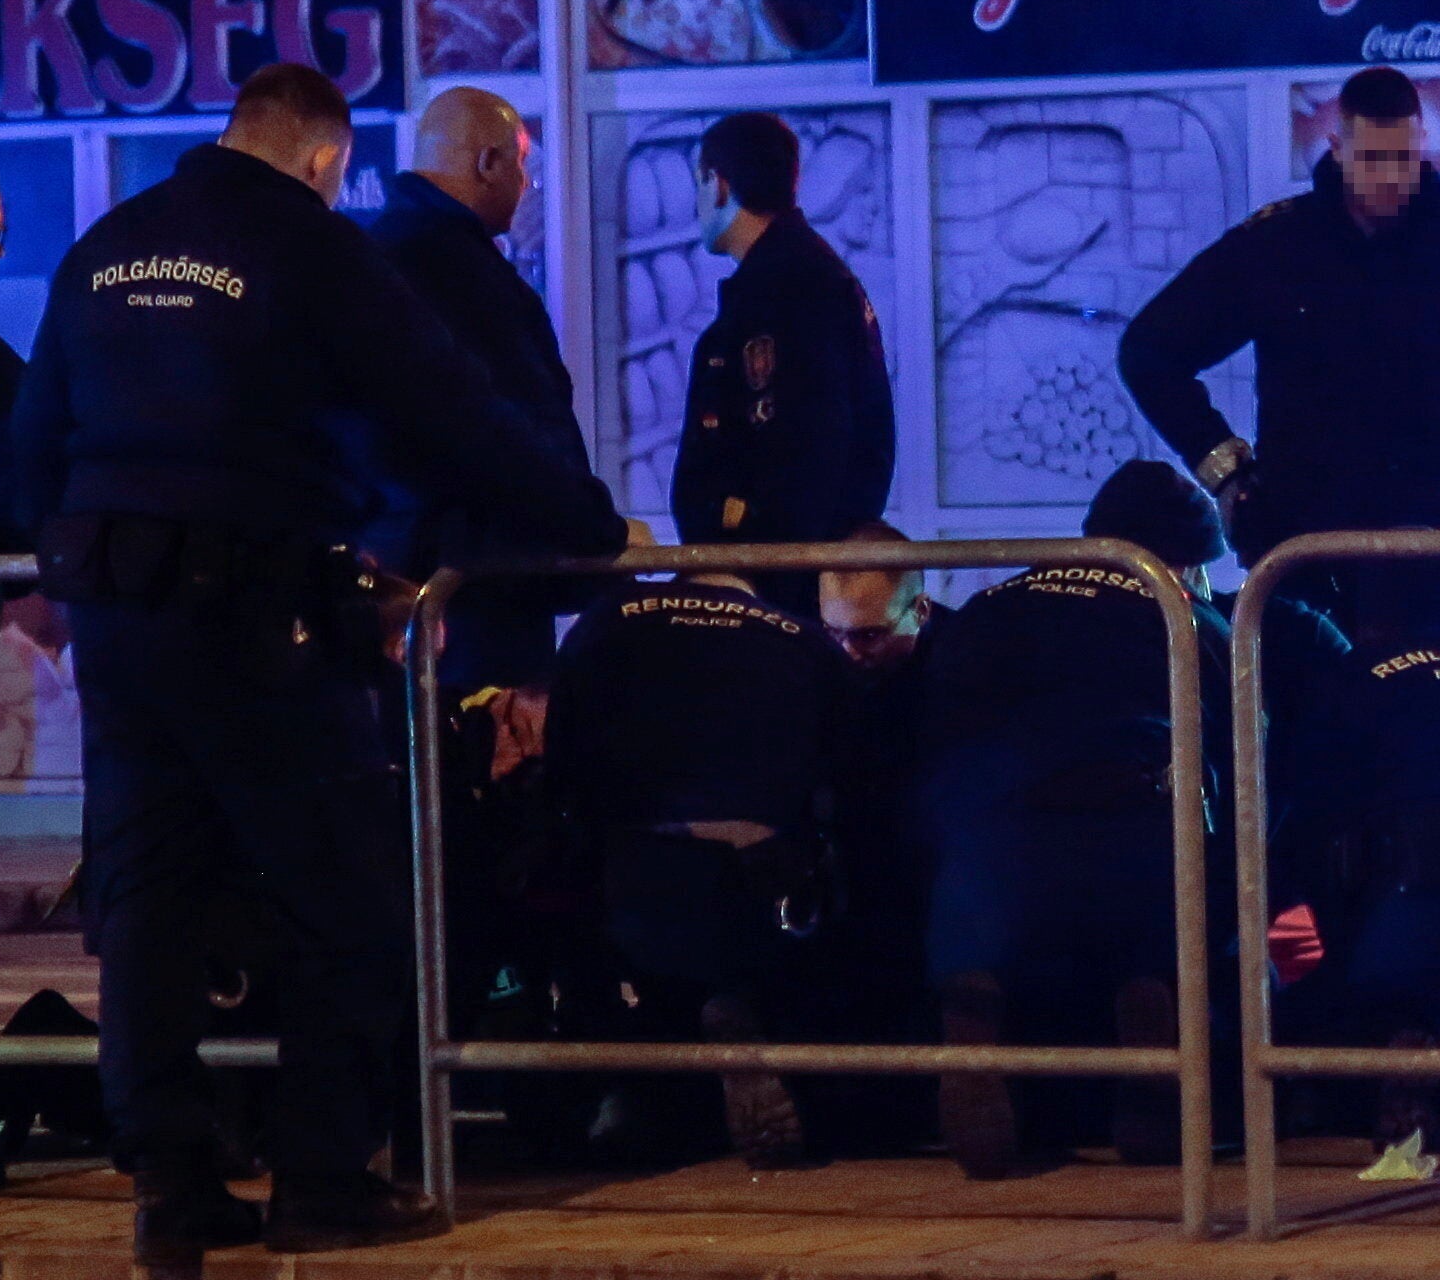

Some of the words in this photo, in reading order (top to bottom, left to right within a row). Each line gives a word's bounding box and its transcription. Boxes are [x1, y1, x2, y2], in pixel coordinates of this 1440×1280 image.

[92, 254, 245, 300] POLGÁRŐRSÉG
[127, 294, 153, 307] CIVIL
[155, 294, 194, 308] GUARD
[1028, 582, 1098, 598] POLICE
